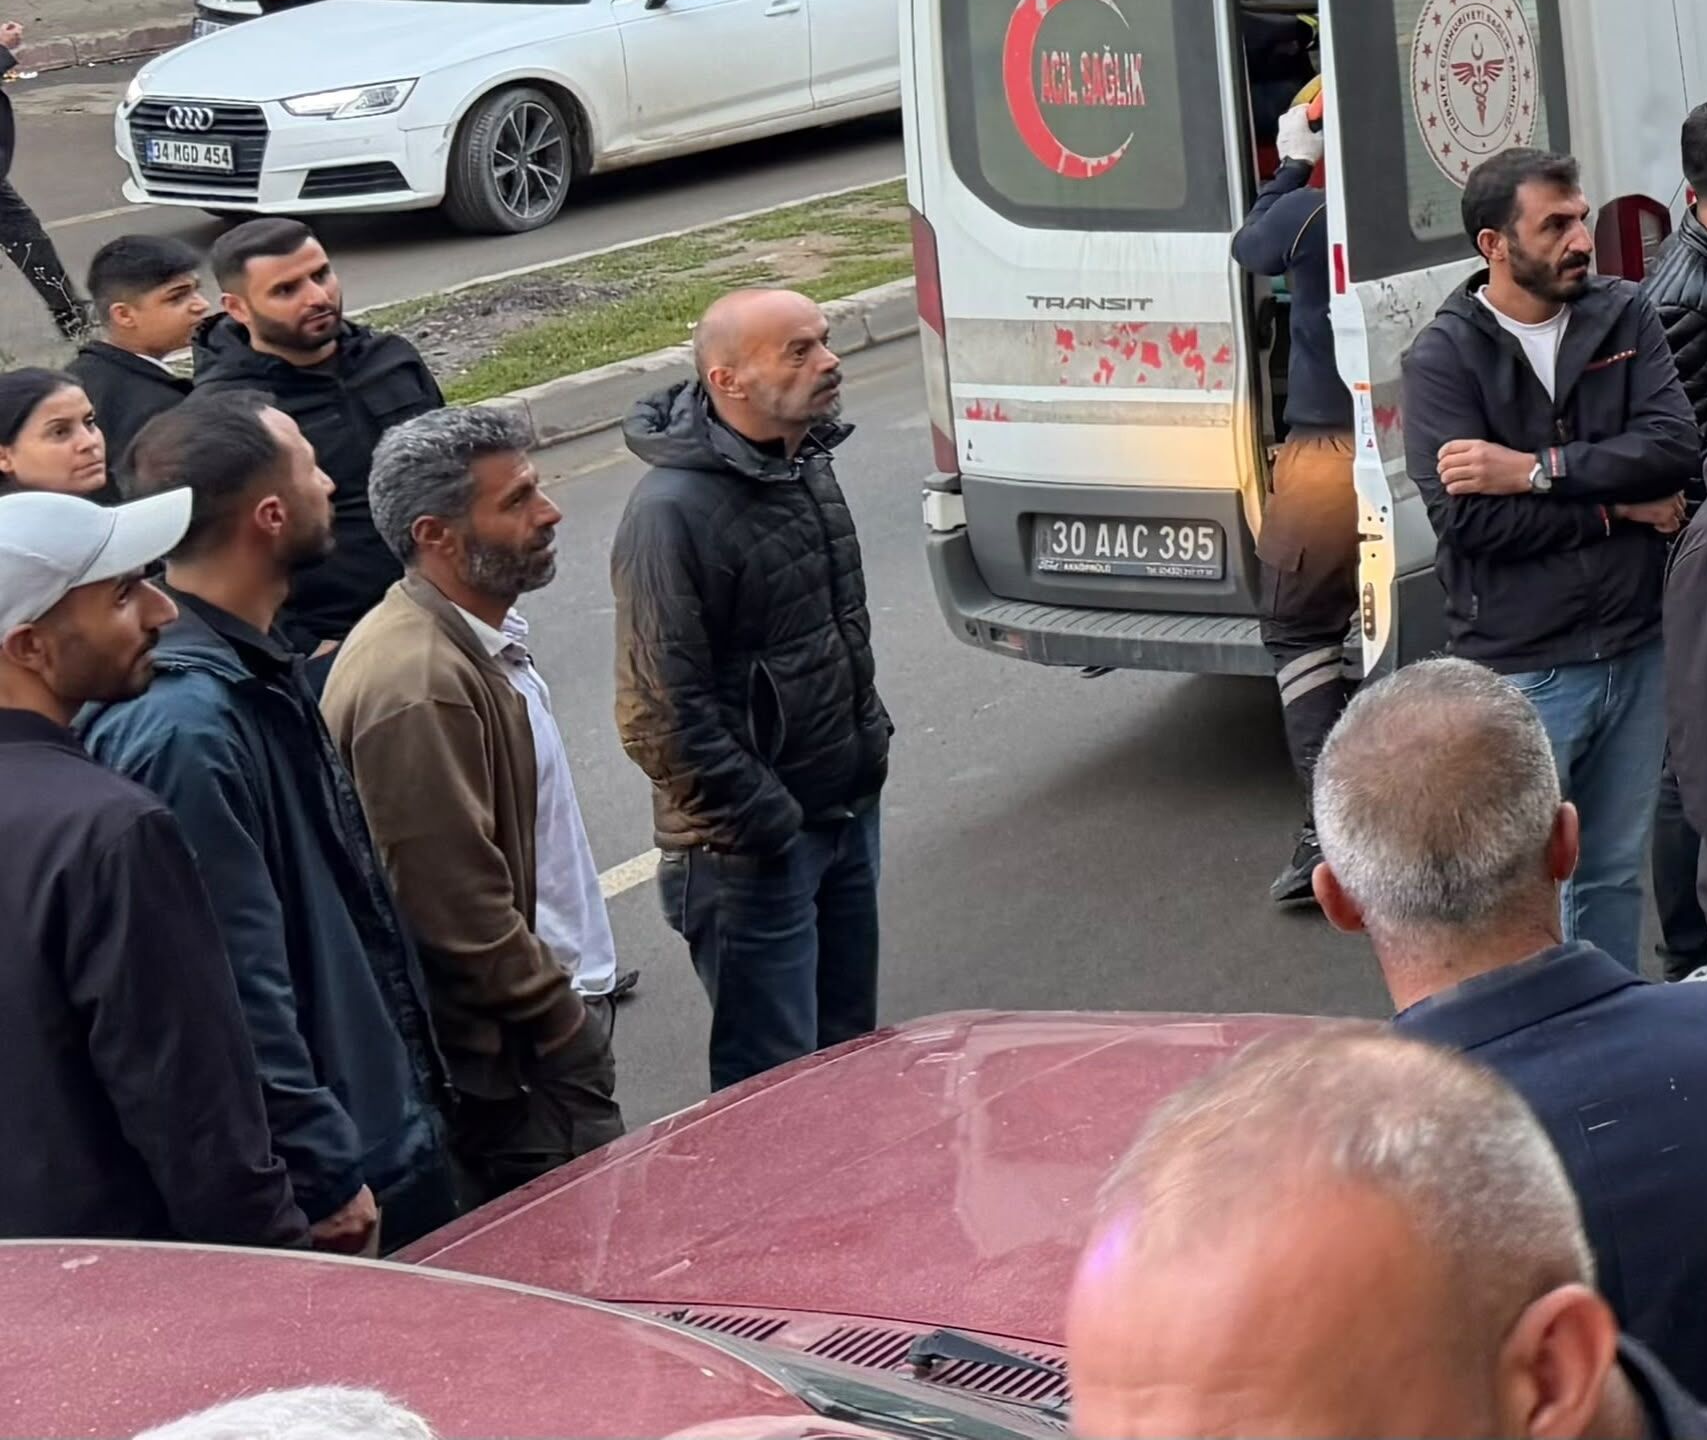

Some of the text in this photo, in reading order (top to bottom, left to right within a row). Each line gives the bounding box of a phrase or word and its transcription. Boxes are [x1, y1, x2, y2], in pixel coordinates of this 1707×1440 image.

[1081, 44, 1146, 107] SAĞLIK
[153, 142, 230, 166] 34 MGD 454
[1026, 295, 1153, 311] TRANSIT
[1052, 520, 1215, 561] 30 AAC 395
